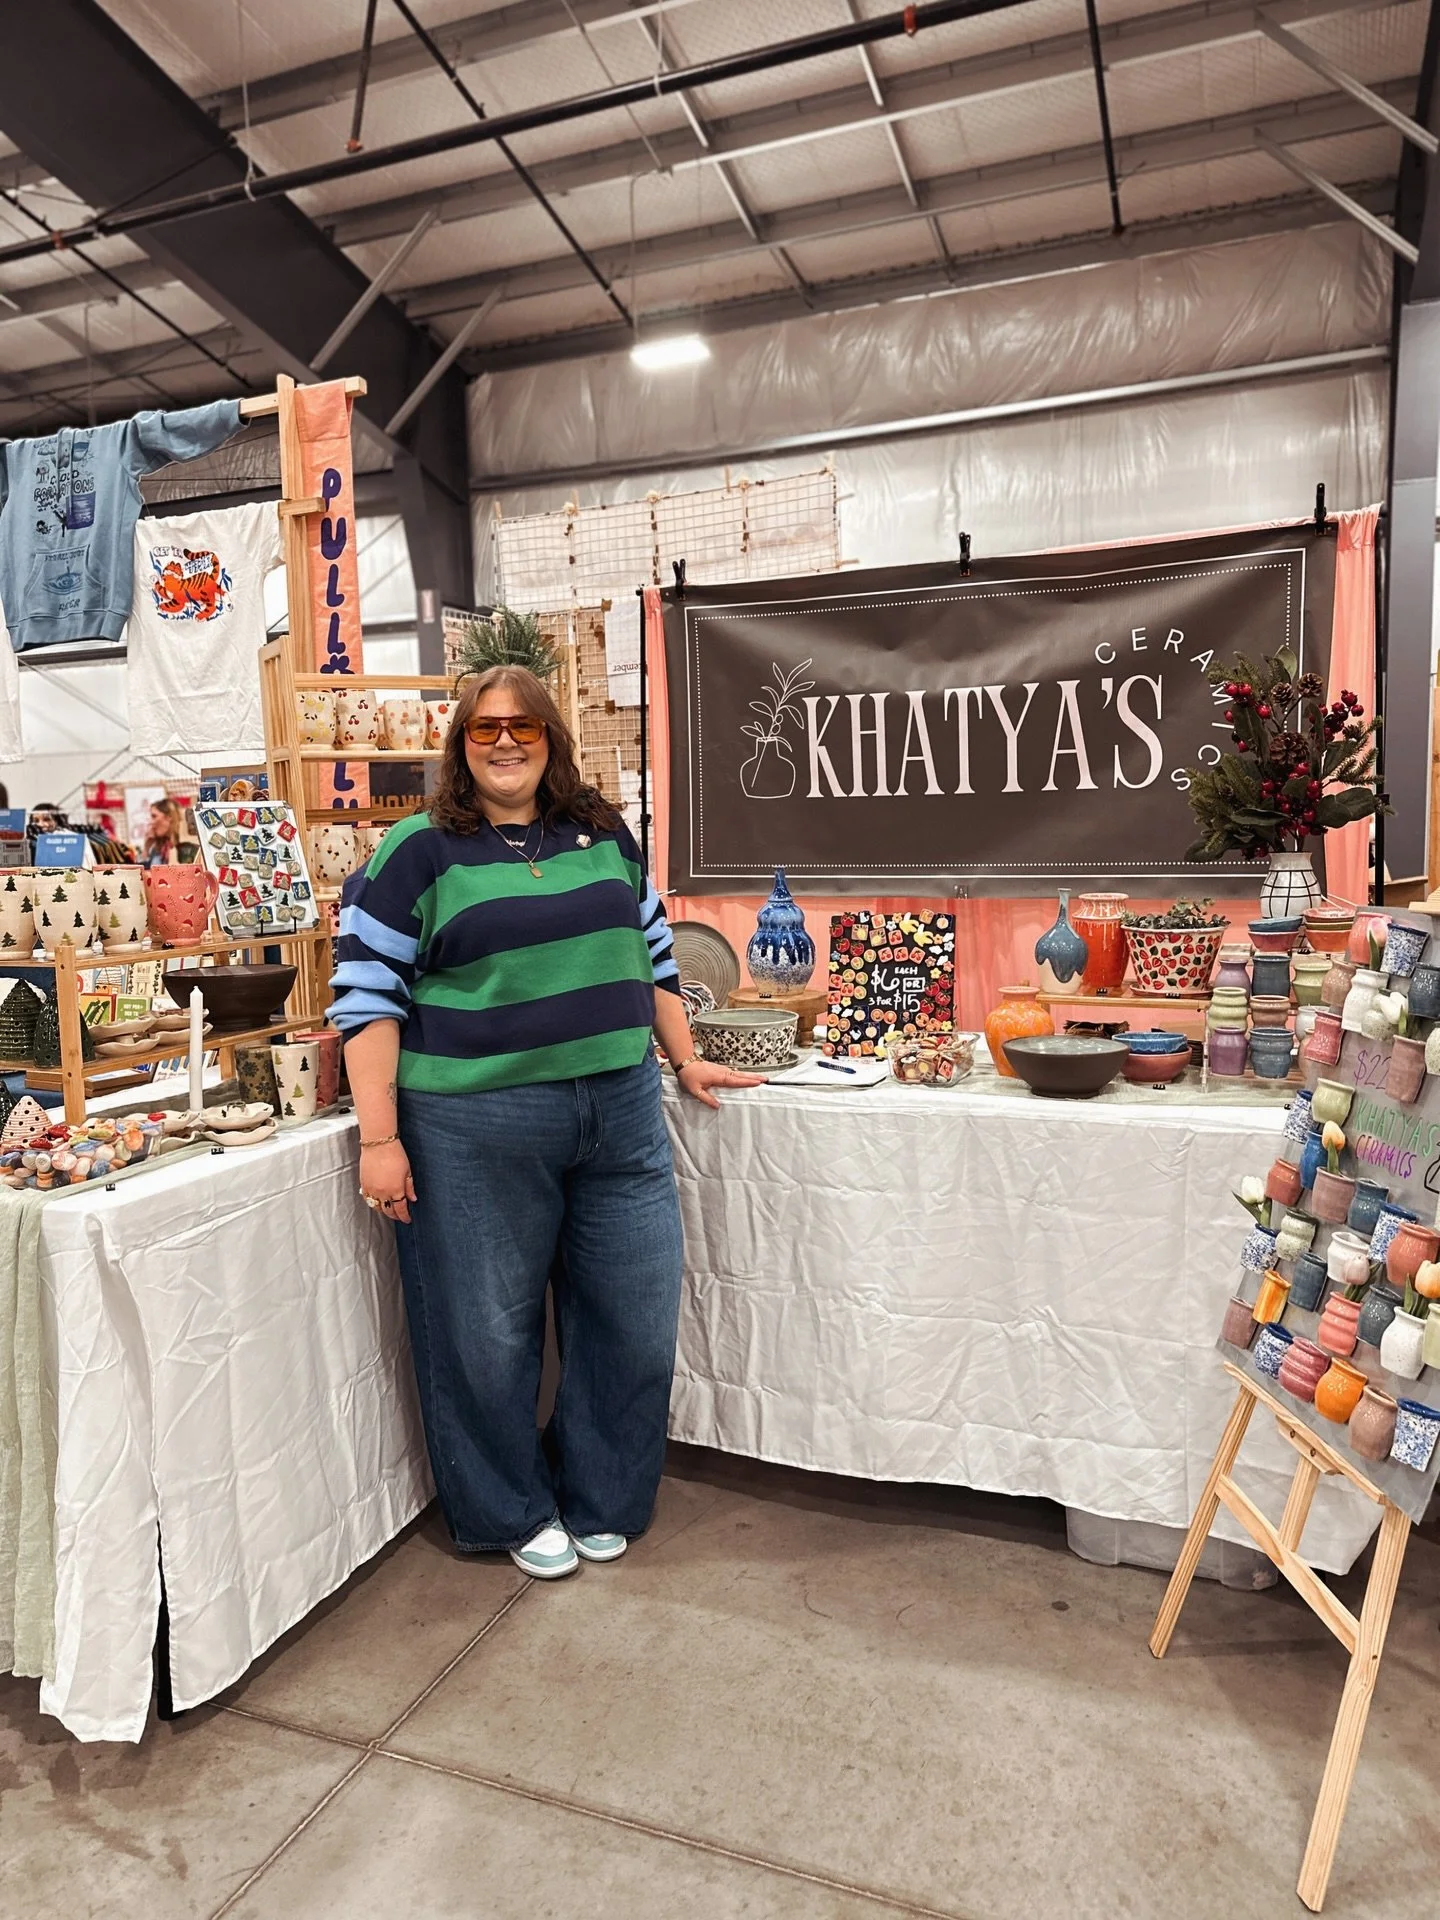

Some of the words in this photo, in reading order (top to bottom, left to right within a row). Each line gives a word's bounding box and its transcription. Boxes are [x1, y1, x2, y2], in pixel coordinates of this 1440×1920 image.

[1094, 626, 1235, 791] CERAMICS
[801, 674, 1164, 798] KHATYA'S
[871, 964, 900, 993] $6
[894, 966, 918, 975] EACH
[906, 980, 920, 988] OR
[868, 997, 875, 1005] 3
[893, 988, 921, 1013] $15
